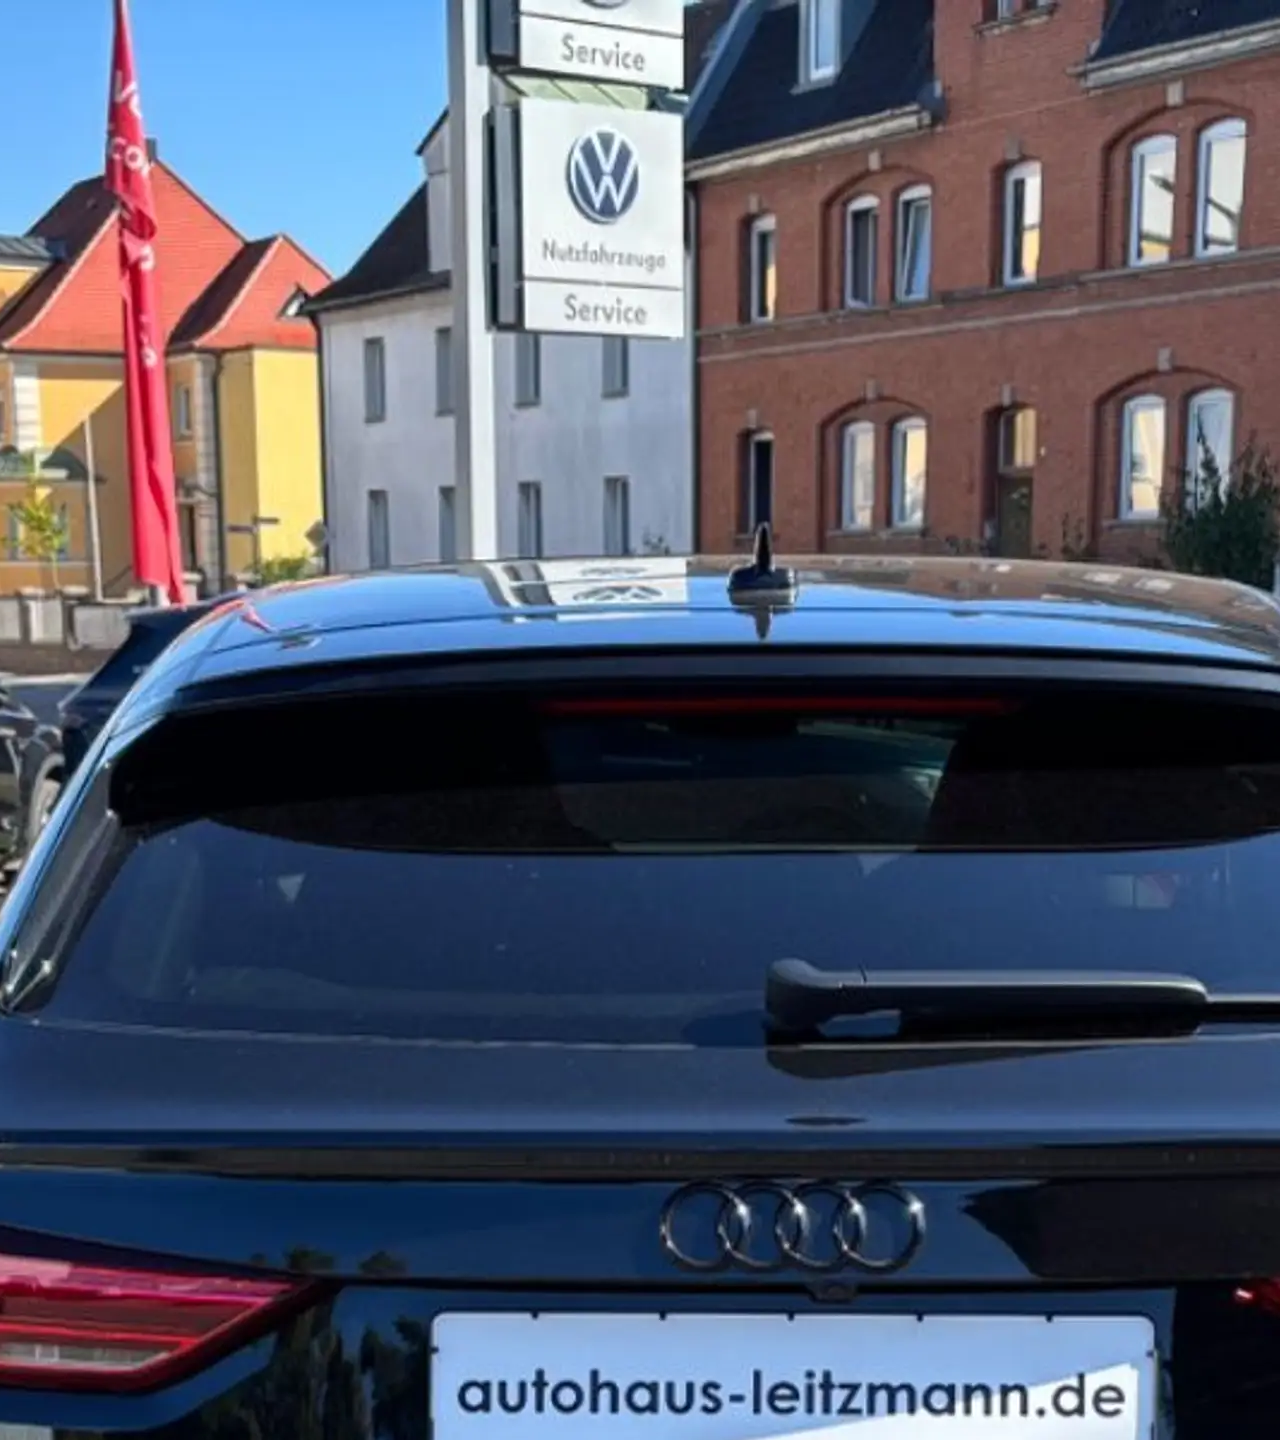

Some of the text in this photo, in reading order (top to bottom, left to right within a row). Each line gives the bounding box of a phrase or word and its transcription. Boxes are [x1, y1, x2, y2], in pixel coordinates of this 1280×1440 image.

[561, 33, 646, 72] Service
[542, 239, 666, 273] Nutzfahrzeuge
[564, 293, 648, 326] Service
[457, 1368, 1127, 1419] autohaus-leitzmann.de
